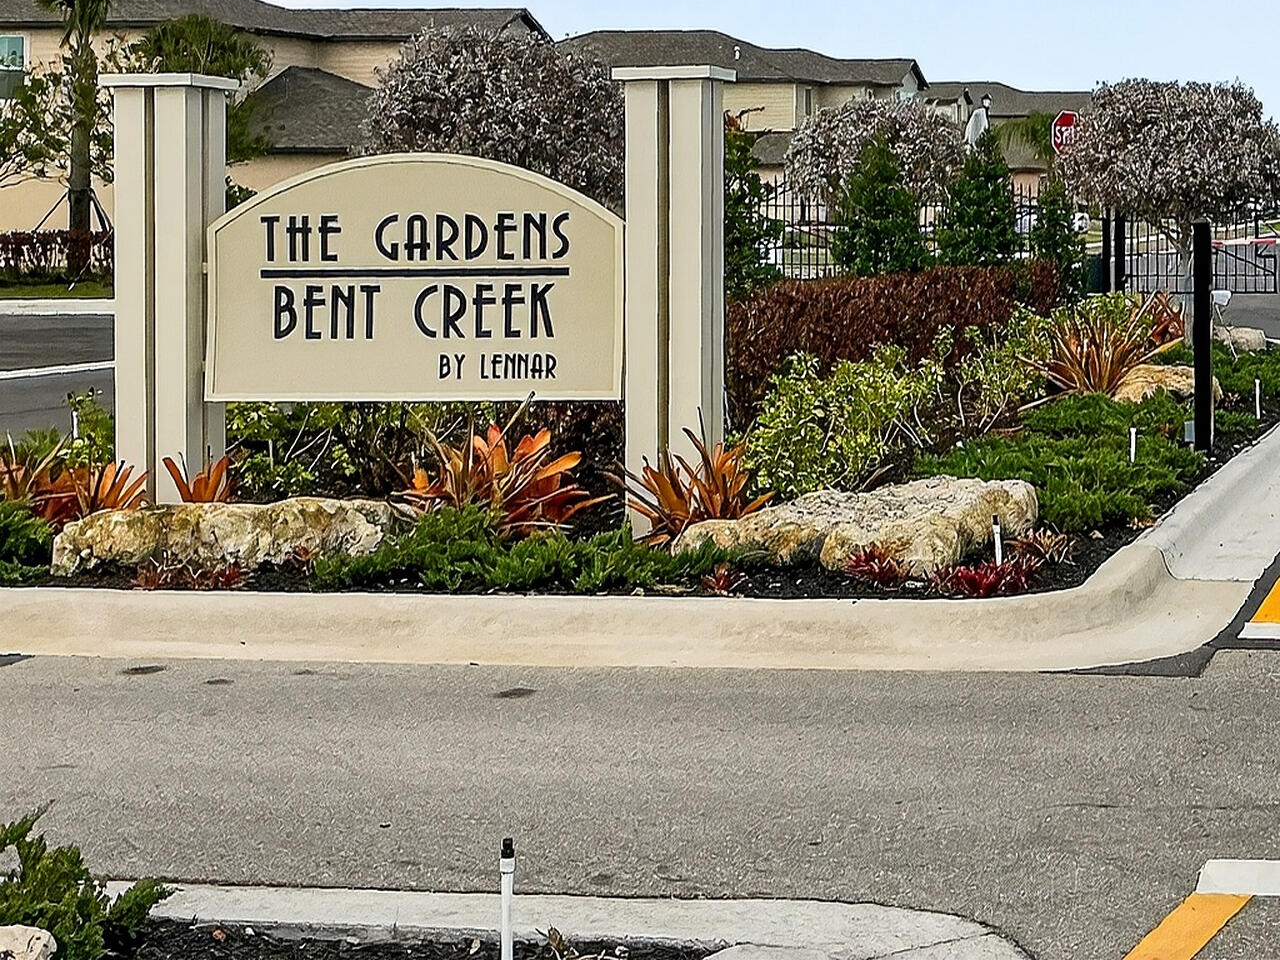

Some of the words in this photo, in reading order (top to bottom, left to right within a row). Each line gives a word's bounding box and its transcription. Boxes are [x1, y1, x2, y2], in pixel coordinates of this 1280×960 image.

[260, 214, 342, 262] THE
[374, 212, 570, 262] GARDENS
[274, 284, 381, 340] BENT
[414, 282, 555, 339] CREEK
[438, 353, 466, 380] BY
[480, 353, 557, 380] LENNAR
